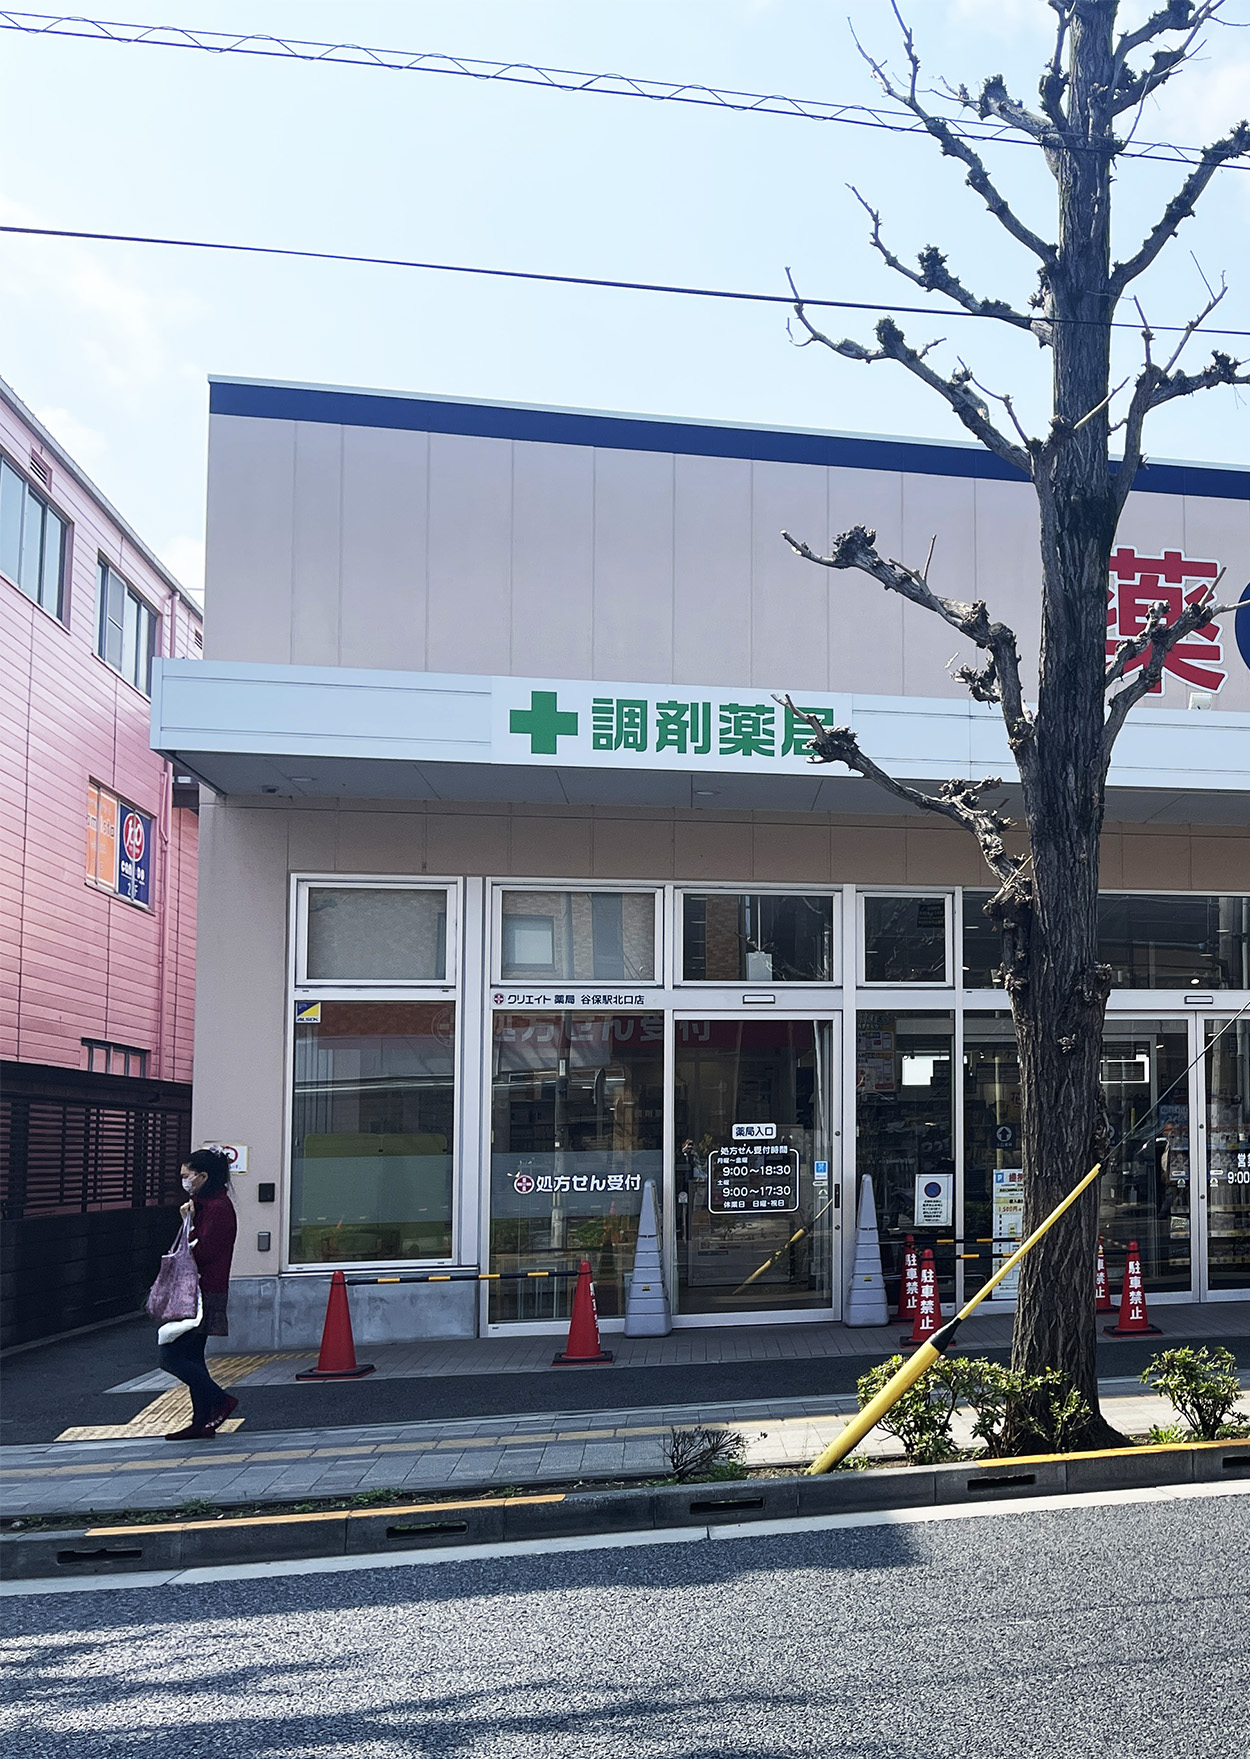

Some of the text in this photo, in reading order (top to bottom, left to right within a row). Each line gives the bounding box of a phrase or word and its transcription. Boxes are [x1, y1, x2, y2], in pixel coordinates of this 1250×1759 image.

[591, 697, 835, 757] 調剤薬局
[507, 994, 645, 1005] クリエイト 薬局 谷保駅北口店
[735, 1126, 774, 1137] 薬局入口
[720, 1145, 788, 1156] 処方せん受付時間
[536, 1174, 642, 1193] 処方せん受付
[723, 1200, 746, 1208] 休業日
[904, 1253, 919, 1309] 駐車禁止
[1128, 1260, 1143, 1320] 駐車禁止
[919, 1268, 935, 1330] 駐車禁止
